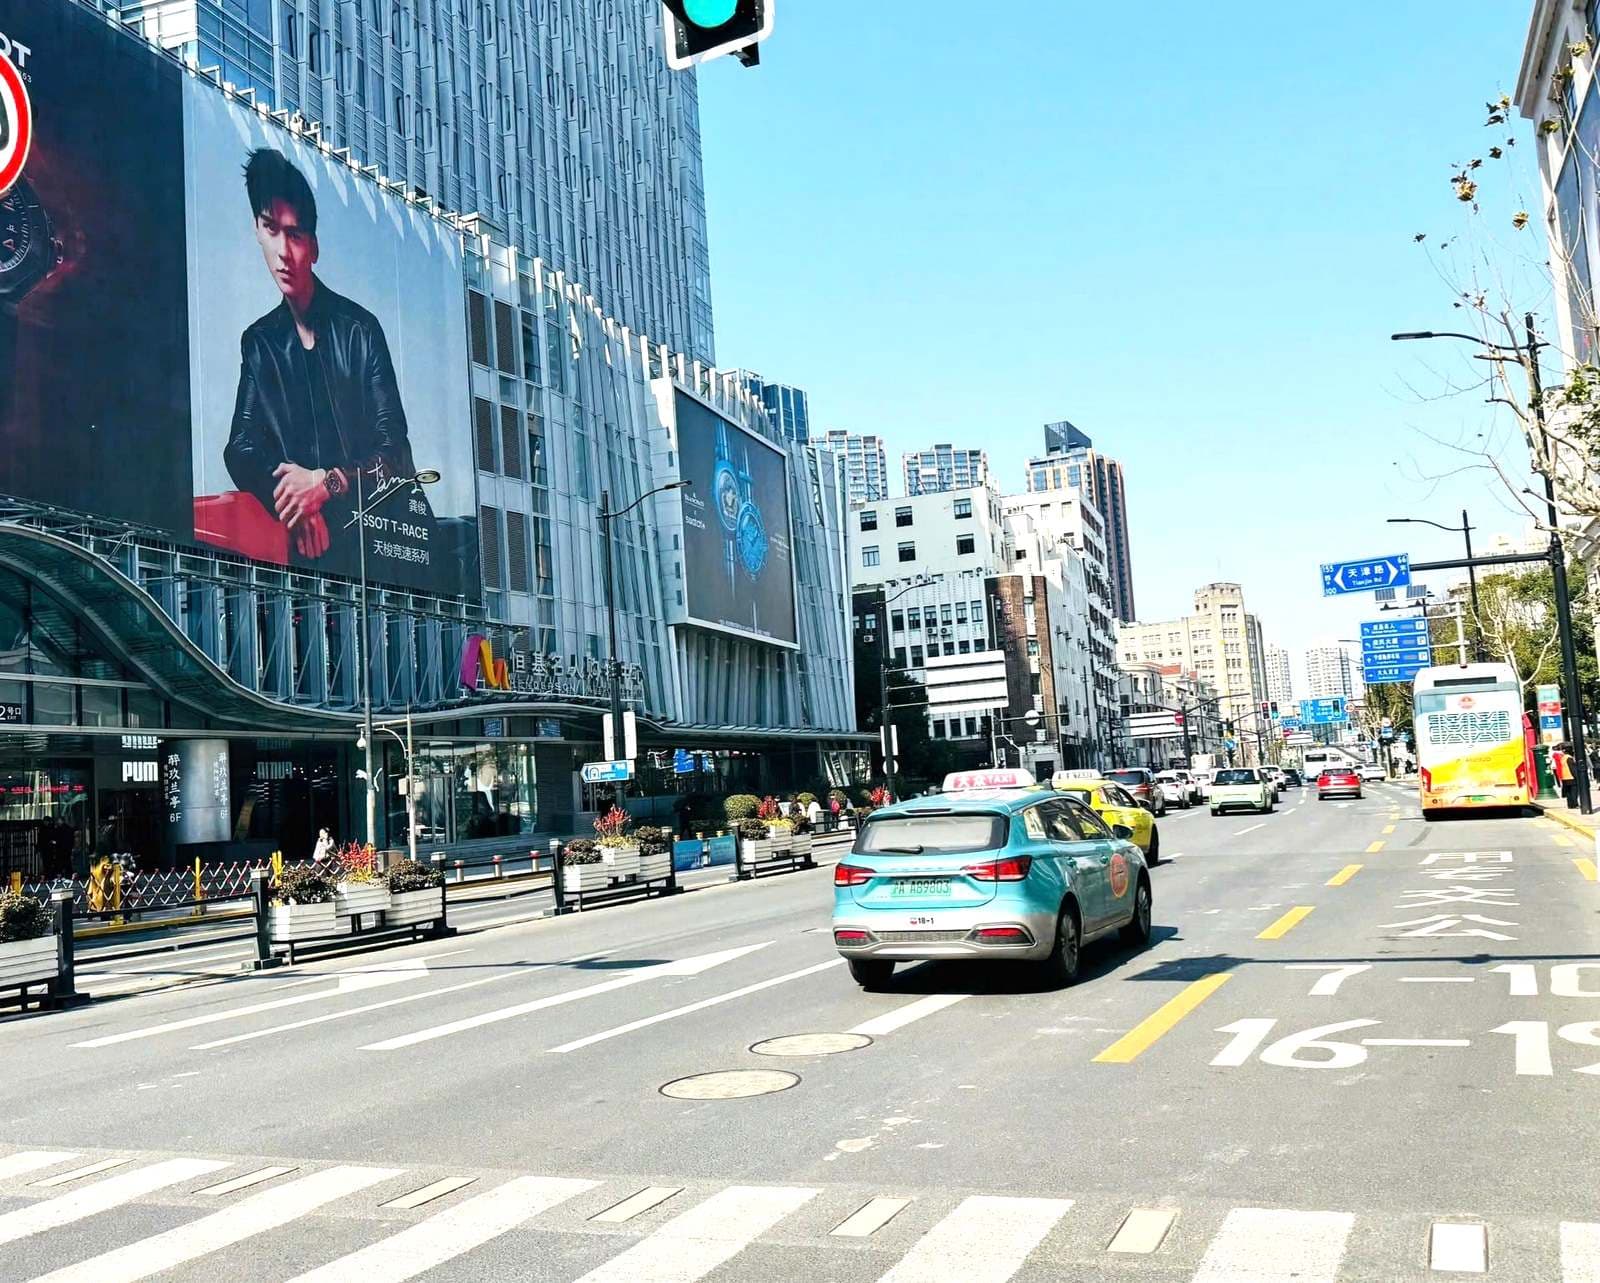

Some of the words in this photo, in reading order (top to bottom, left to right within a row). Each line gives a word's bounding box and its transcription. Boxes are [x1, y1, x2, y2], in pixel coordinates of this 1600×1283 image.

[352, 510, 390, 532] TSSOT
[390, 519, 430, 541] T-RACE
[1347, 564, 1385, 579] 天津路
[170, 812, 182, 823] 6F
